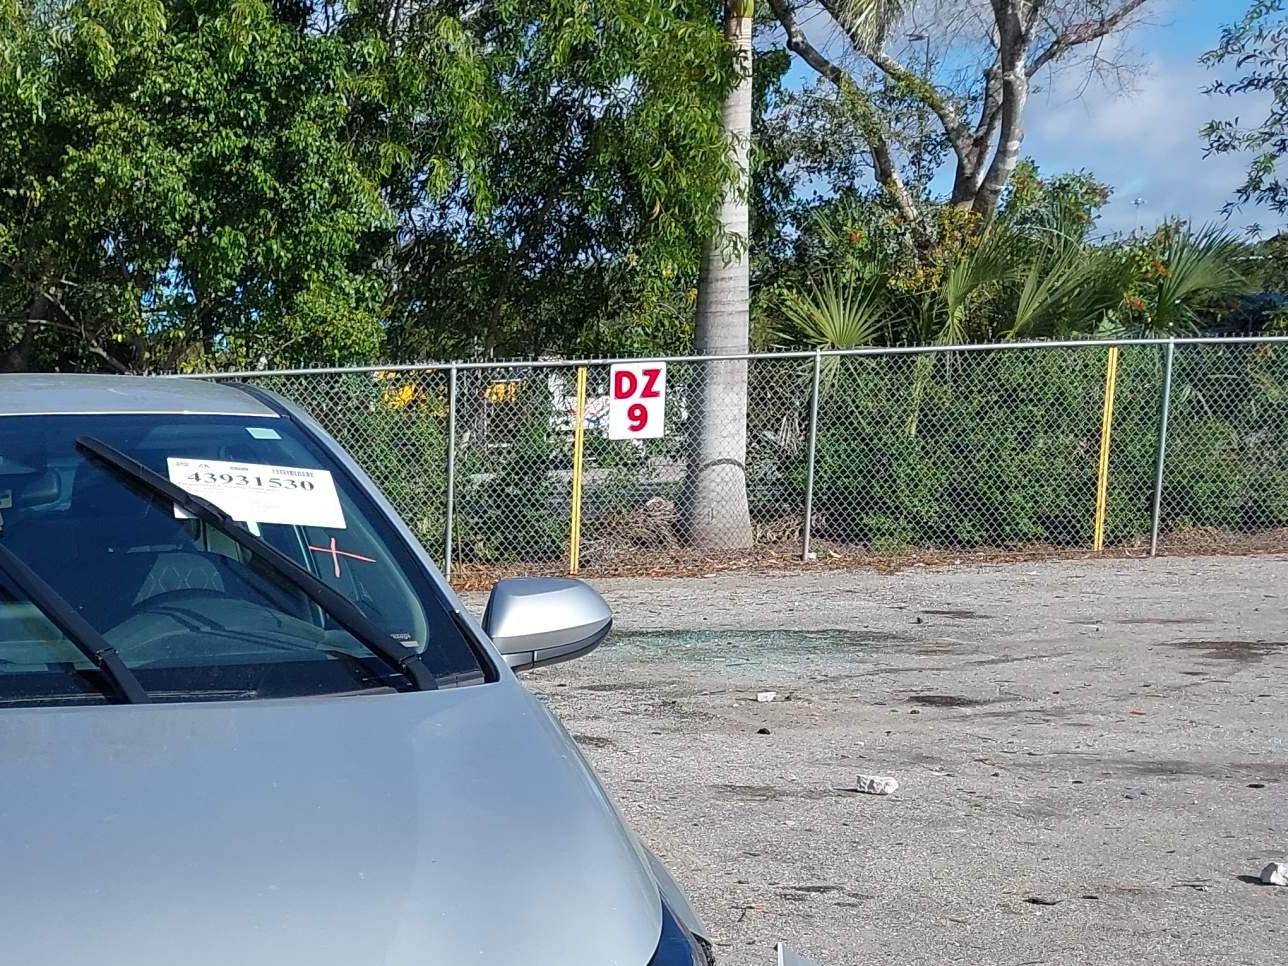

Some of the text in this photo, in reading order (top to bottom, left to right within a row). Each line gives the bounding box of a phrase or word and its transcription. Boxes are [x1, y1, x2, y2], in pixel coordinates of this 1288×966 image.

[614, 369, 662, 400] DZ
[627, 403, 648, 432] 9
[187, 471, 315, 492] 43931530
